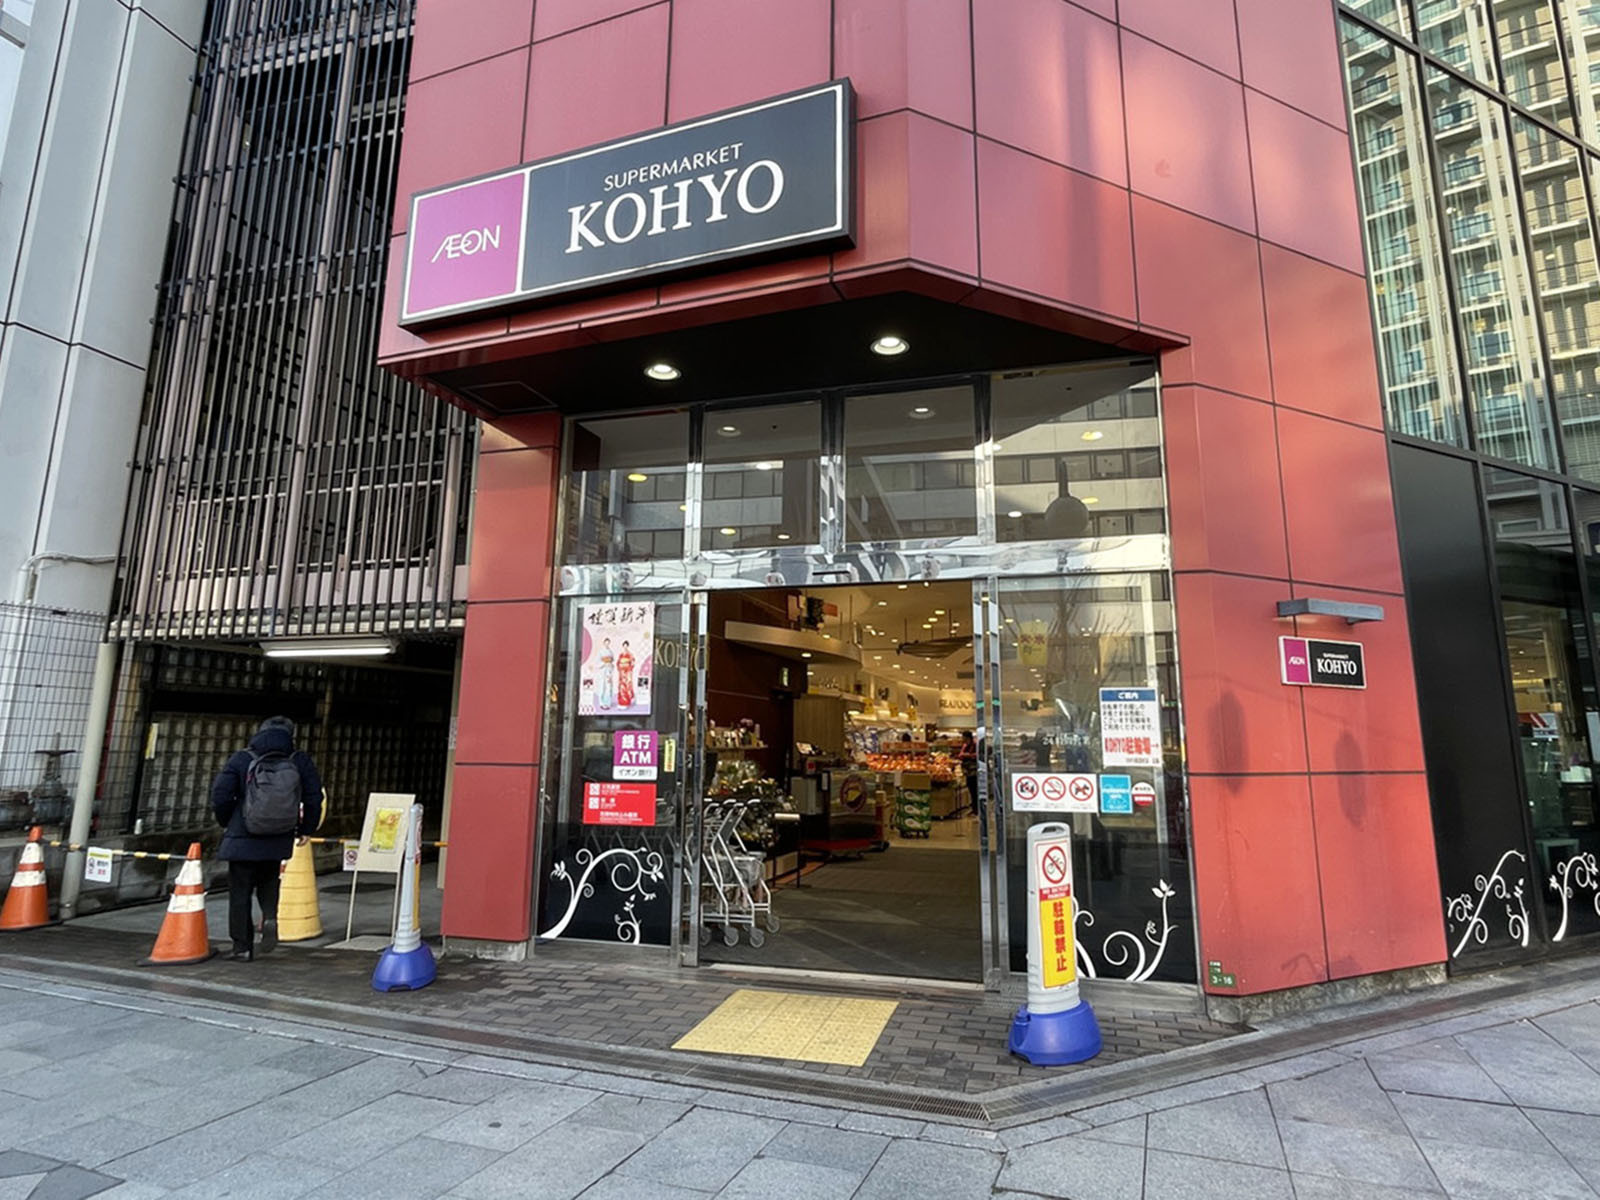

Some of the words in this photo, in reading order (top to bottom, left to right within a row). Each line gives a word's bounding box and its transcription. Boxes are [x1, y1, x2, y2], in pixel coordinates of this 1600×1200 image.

[603, 142, 744, 192] SUPERMARKET
[564, 159, 785, 255] KOHYO
[431, 224, 501, 263] AEON
[1316, 658, 1357, 676] KOHYO
[939, 698, 976, 710] SEAFOO
[621, 734, 651, 750] 銀行
[620, 750, 652, 764] ATM
[1052, 901, 1067, 973] 駐輪禁止
